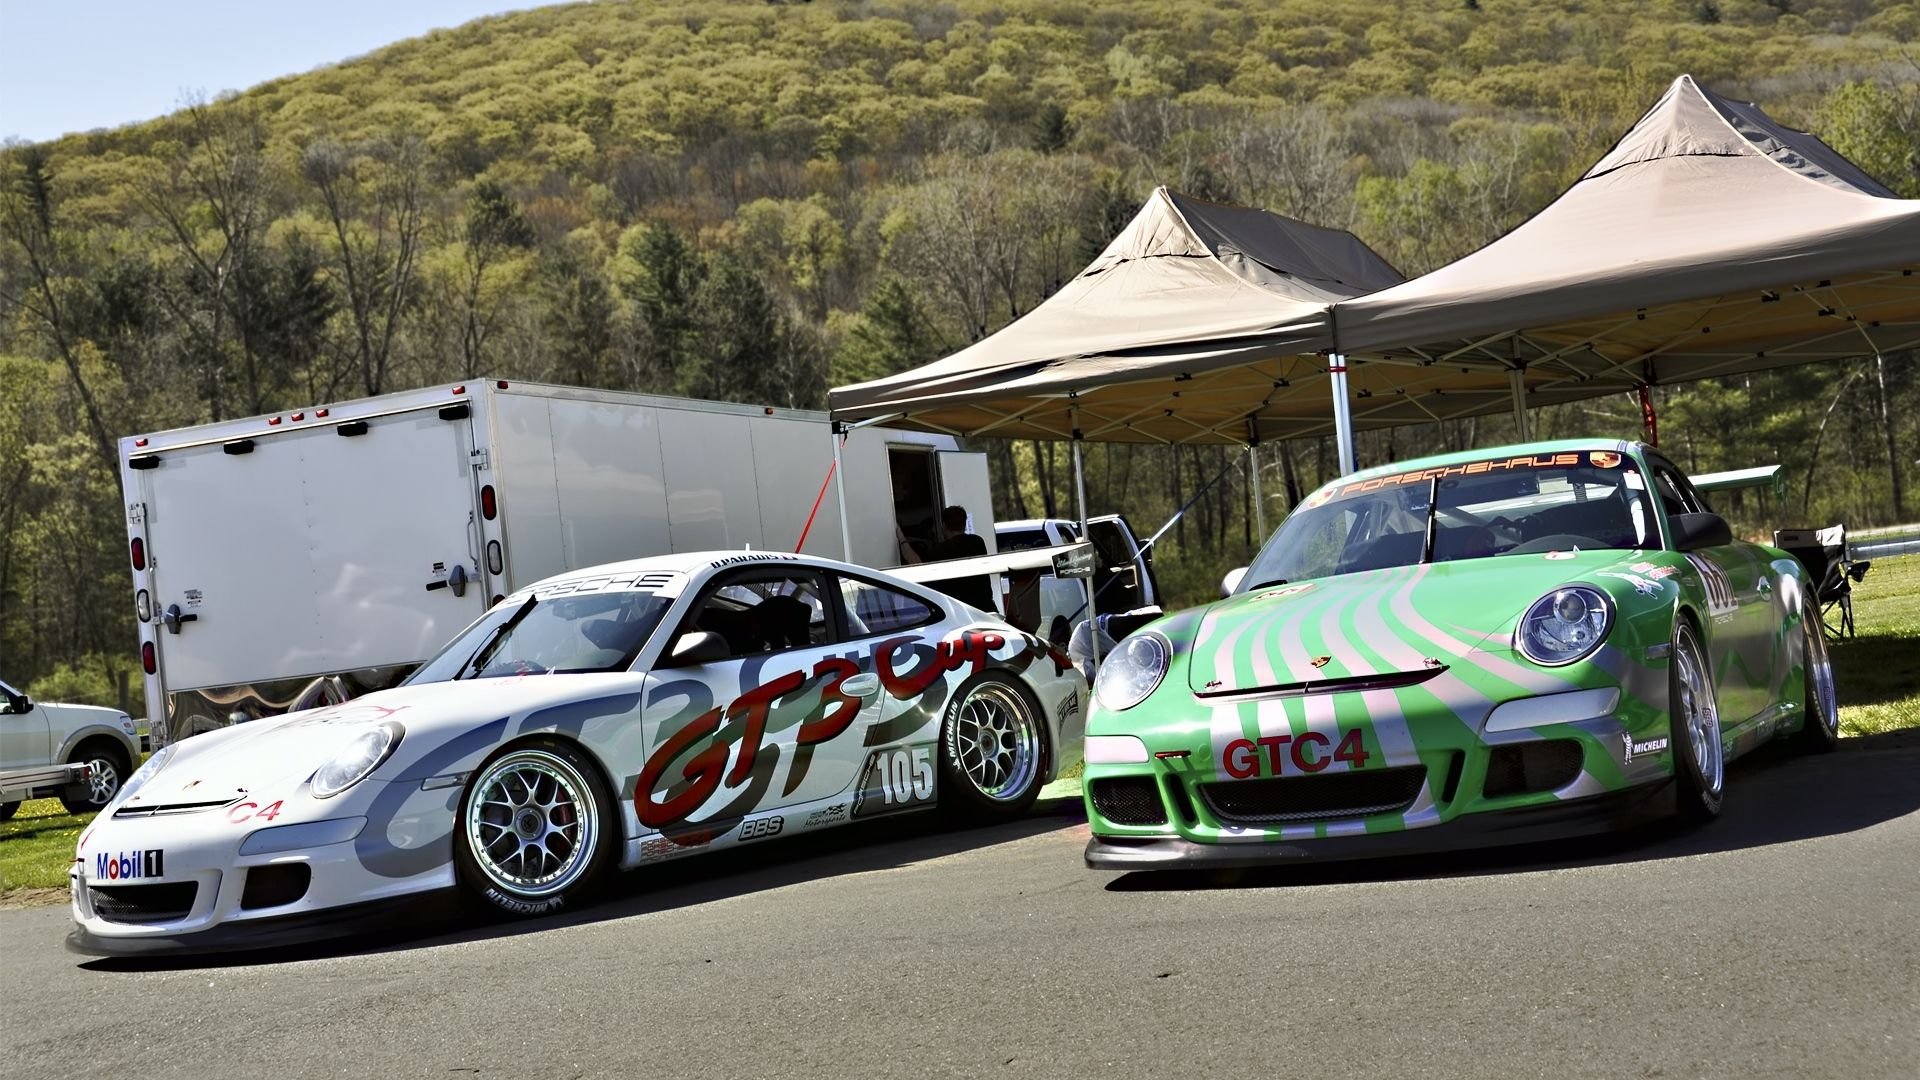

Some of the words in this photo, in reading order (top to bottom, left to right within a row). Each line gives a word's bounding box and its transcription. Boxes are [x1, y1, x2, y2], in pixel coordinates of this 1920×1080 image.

[1343, 454, 1578, 496] PORSCHEHAUS
[875, 634, 1005, 700] Cup
[946, 701, 958, 758] MICHELIN
[1633, 738, 1668, 753] MICHELIN
[1222, 728, 1369, 779] GTC4
[876, 748, 933, 804] 105
[738, 816, 784, 841] BBS
[97, 850, 142, 880] Mobil
[485, 887, 549, 914] MICHELIN
